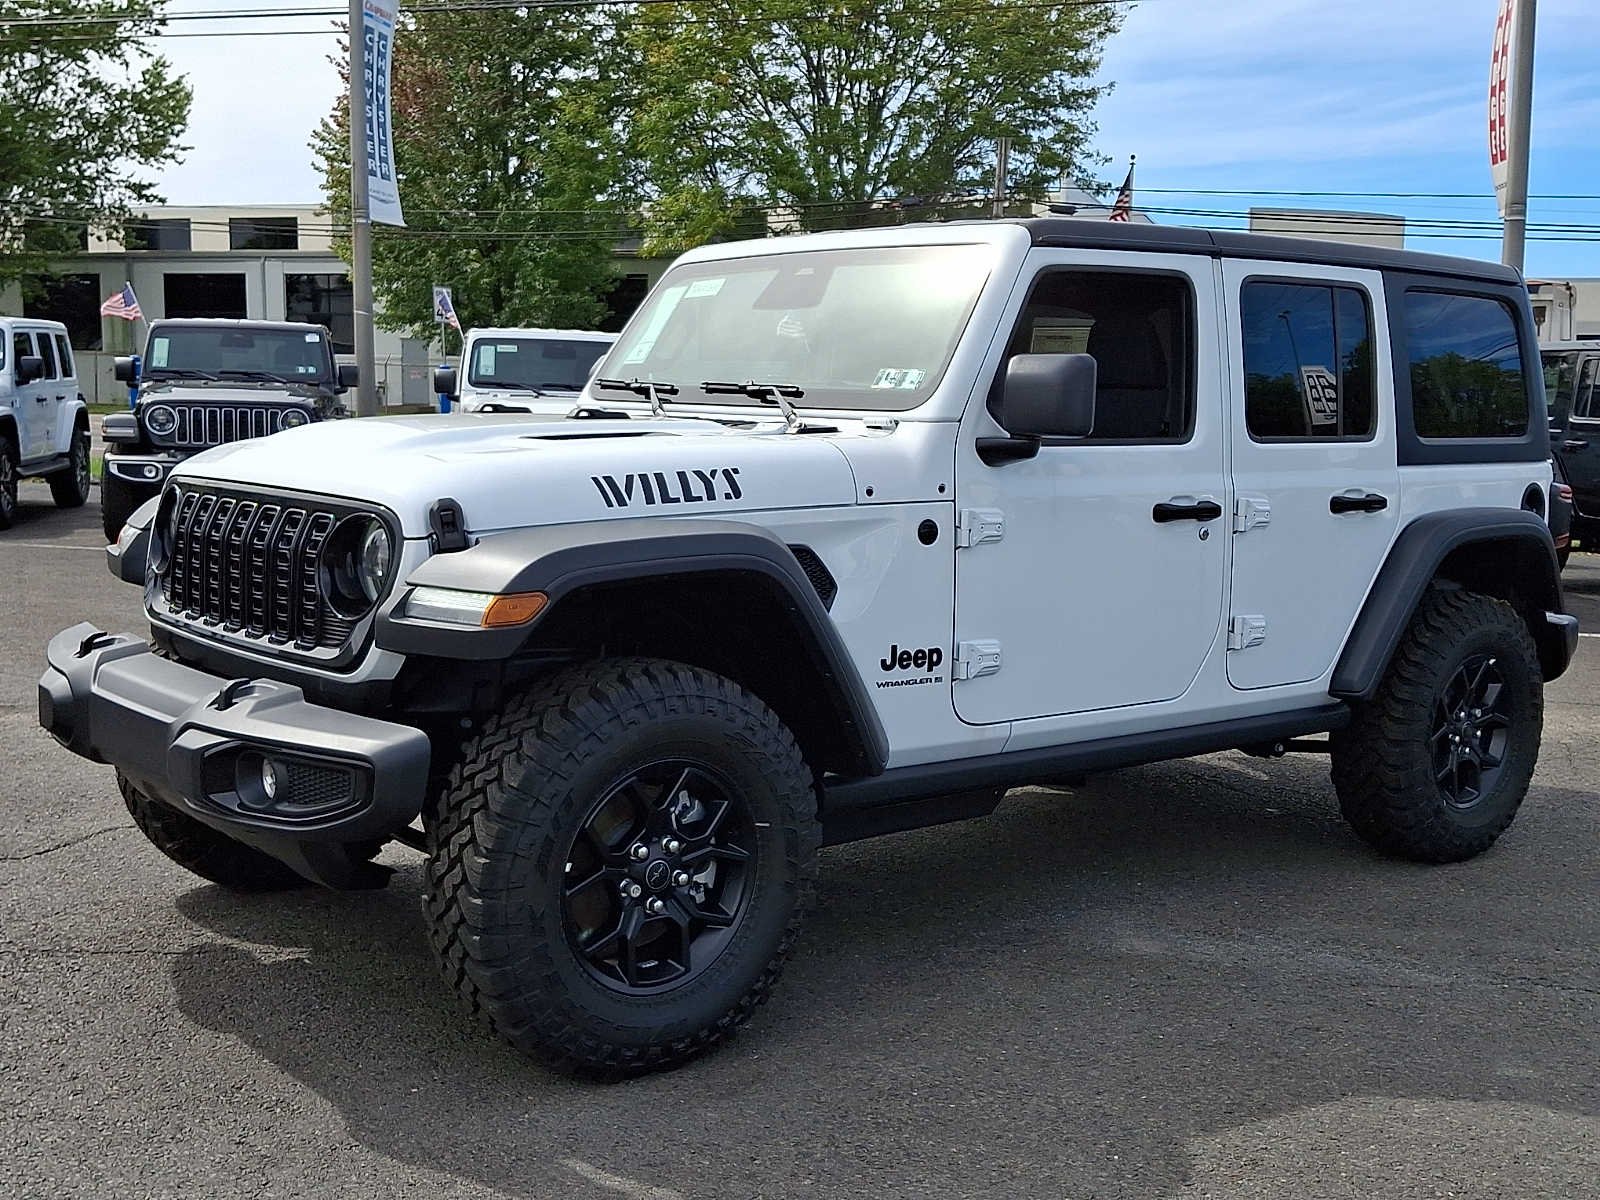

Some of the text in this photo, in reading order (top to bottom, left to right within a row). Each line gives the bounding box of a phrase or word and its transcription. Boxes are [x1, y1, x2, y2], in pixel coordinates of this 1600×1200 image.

[364, 33, 377, 171] CHRYSLER
[377, 40, 389, 175] CHRYSLER
[590, 467, 743, 508] WILLYS
[880, 644, 943, 673] Jeep
[875, 677, 932, 689] WRANGLER
